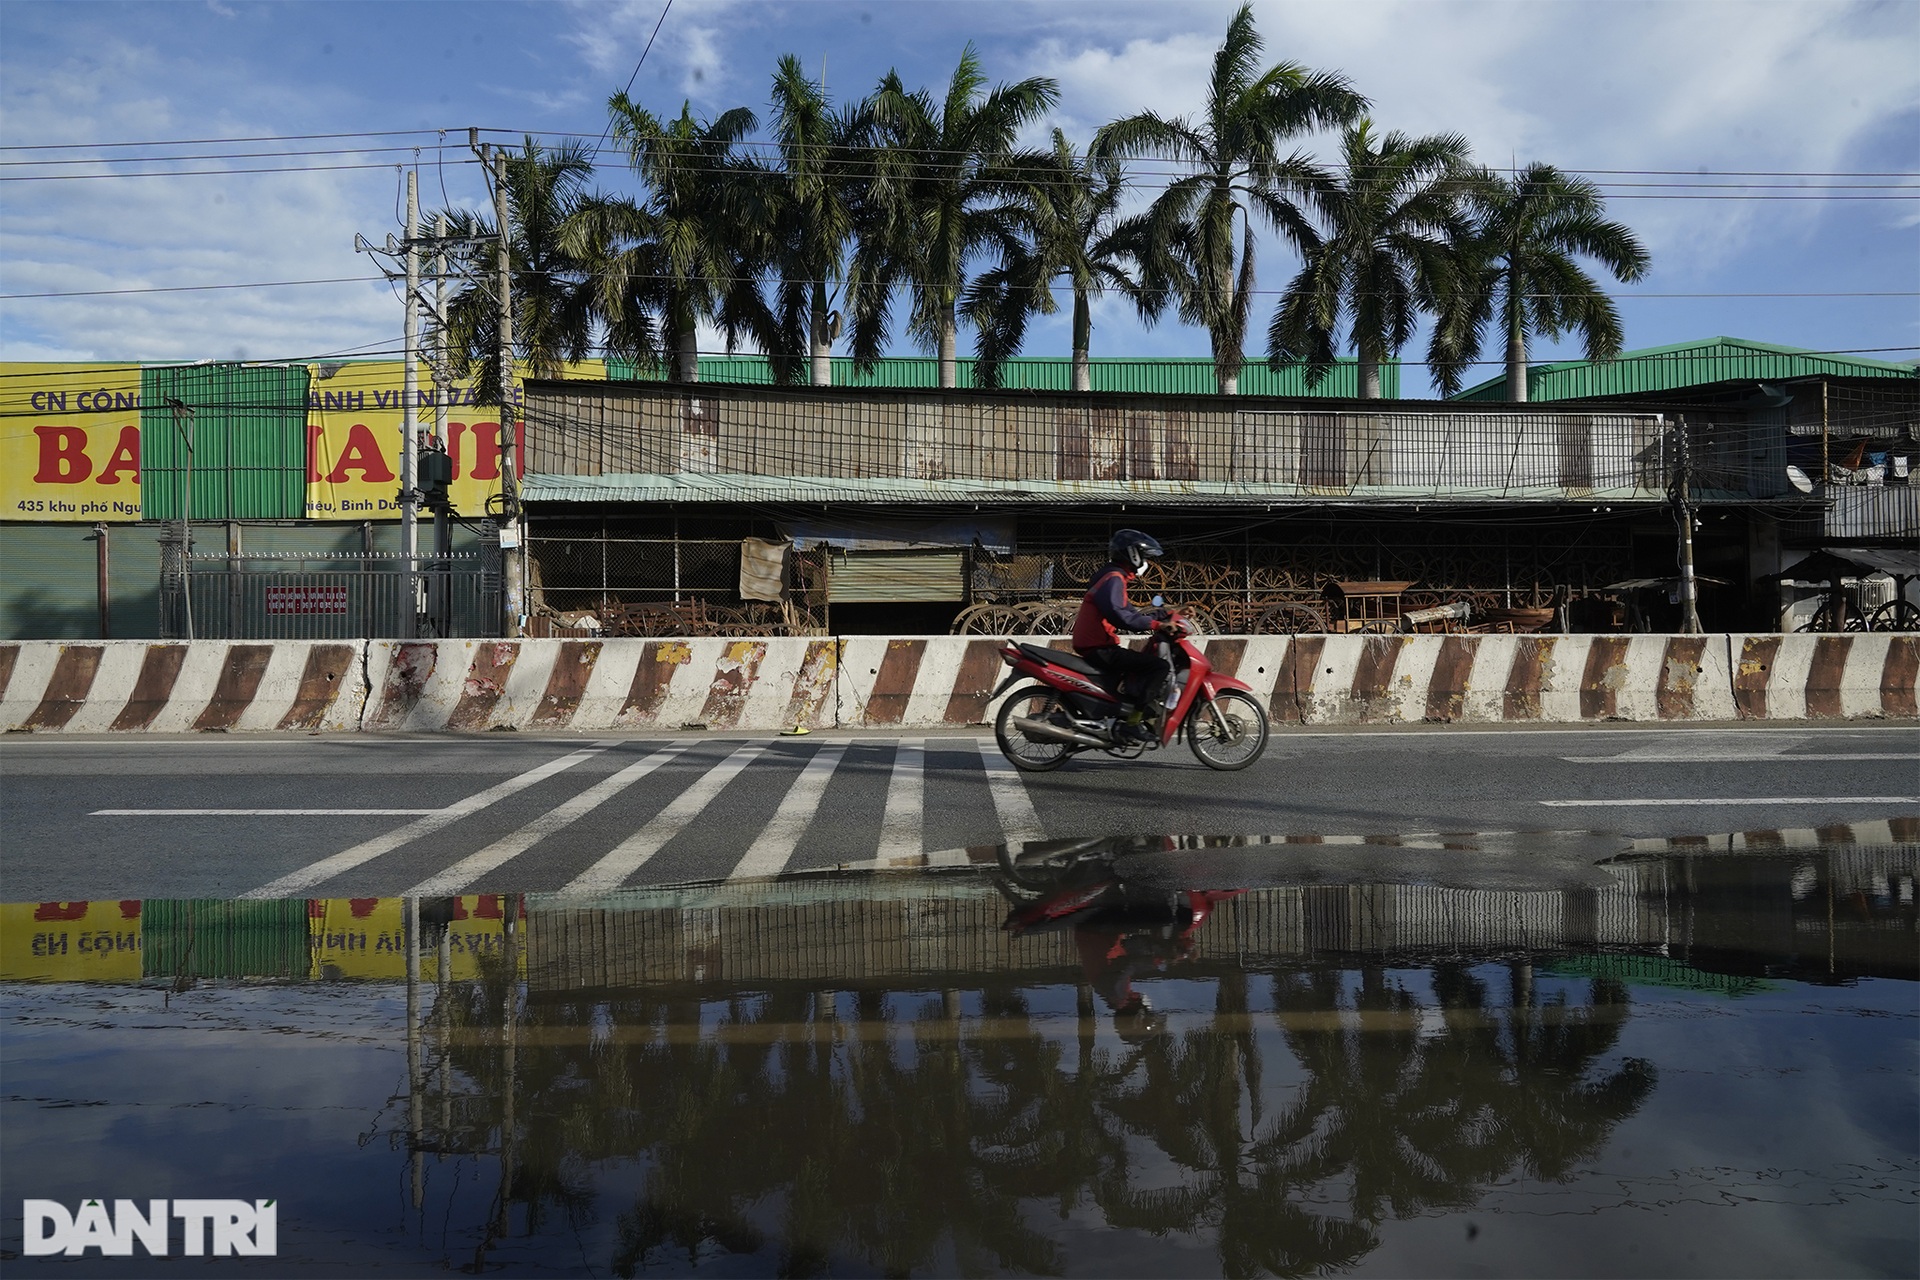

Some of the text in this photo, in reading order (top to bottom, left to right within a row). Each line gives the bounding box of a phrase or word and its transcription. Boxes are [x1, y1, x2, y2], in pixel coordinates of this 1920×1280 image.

[31, 391, 66, 411] CN
[77, 388, 141, 411] CÔN
[373, 389, 435, 409] VIN
[17, 500, 44, 512] 435
[49, 500, 76, 512] khu
[81, 500, 108, 515] phố
[341, 499, 373, 511] Bình
